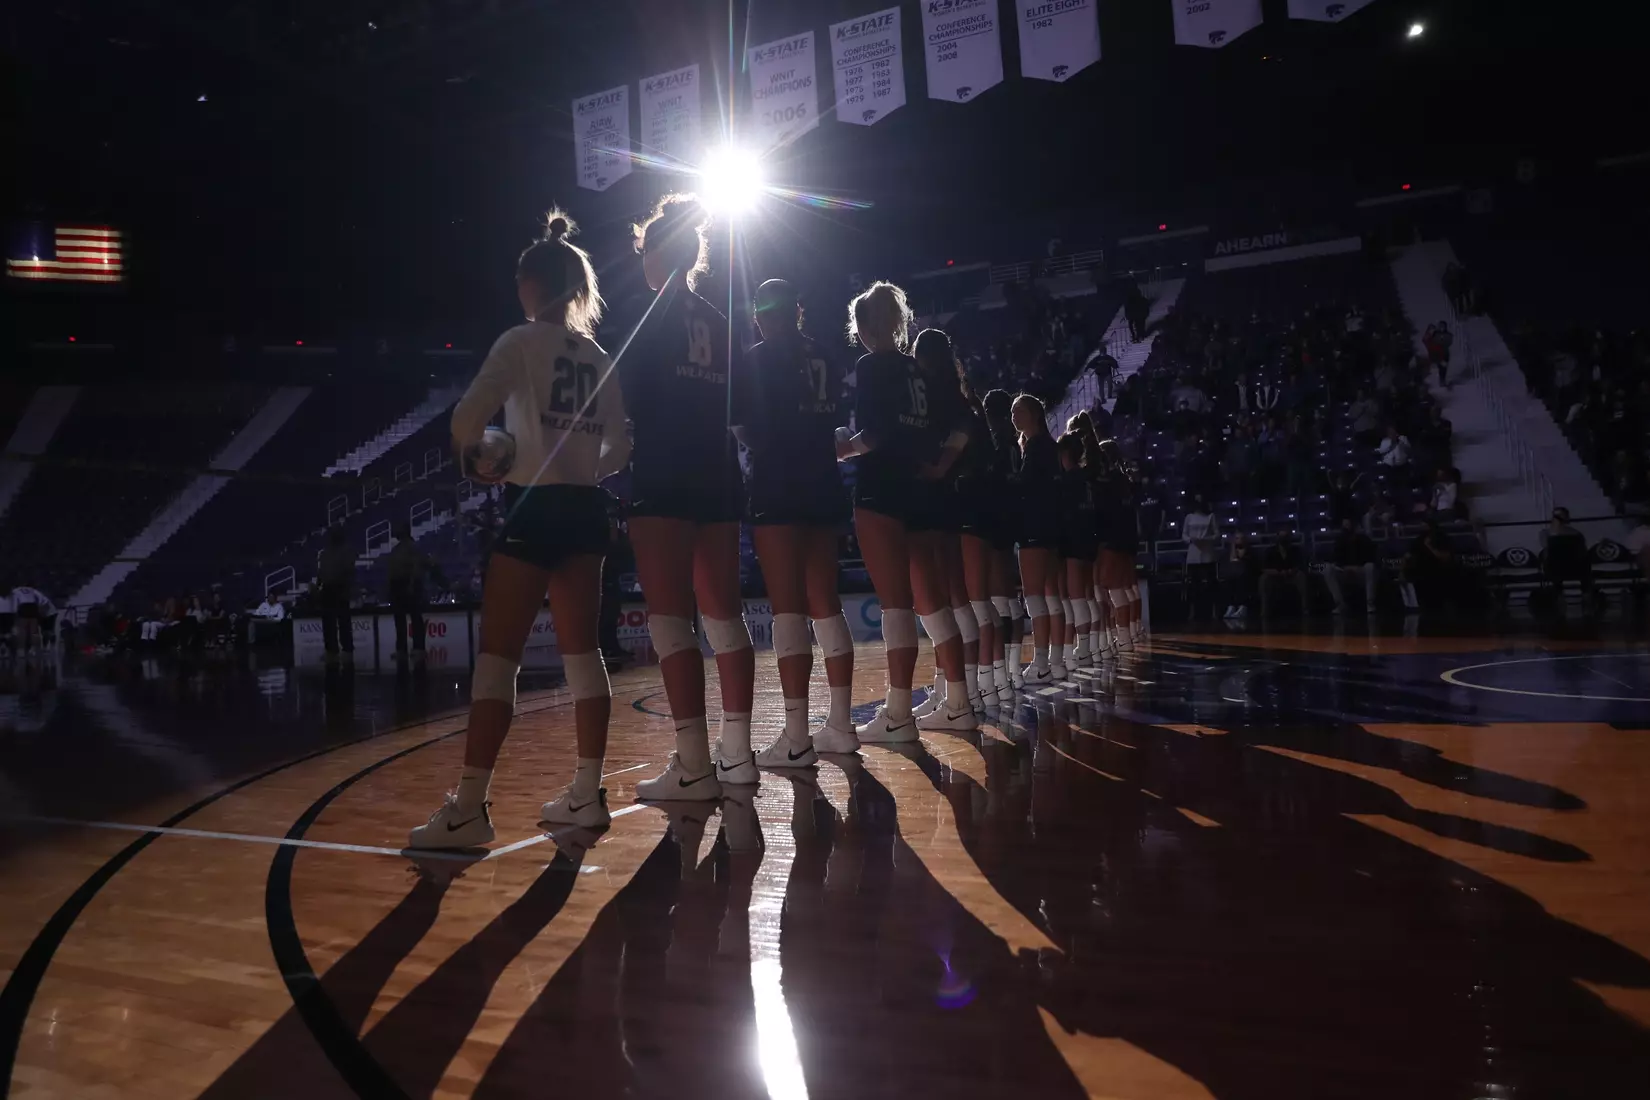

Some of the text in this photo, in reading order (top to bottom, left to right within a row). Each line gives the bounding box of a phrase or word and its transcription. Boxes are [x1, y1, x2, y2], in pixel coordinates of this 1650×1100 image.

[1026, 0, 1086, 18] ELITE EIGHT
[1186, 2, 1211, 15] 2002
[837, 13, 895, 39] K-STATE
[928, 20, 993, 41] CHAMPIONSHIPS
[936, 14, 987, 32] CONFERENCE
[1032, 18, 1053, 30] 1982
[754, 38, 809, 62] K-STATE
[836, 45, 896, 66] CHAMPIONSHIPS
[843, 39, 890, 57] CONFERENCE
[936, 42, 958, 53] 2004
[644, 71, 694, 93] K-STATE
[769, 69, 796, 84] WNIT
[754, 76, 812, 100] CHAMPIONS
[577, 91, 623, 112] K-STATE
[1214, 231, 1288, 255] AHEARN
[548, 356, 598, 418] 20
[907, 377, 928, 416] 16
